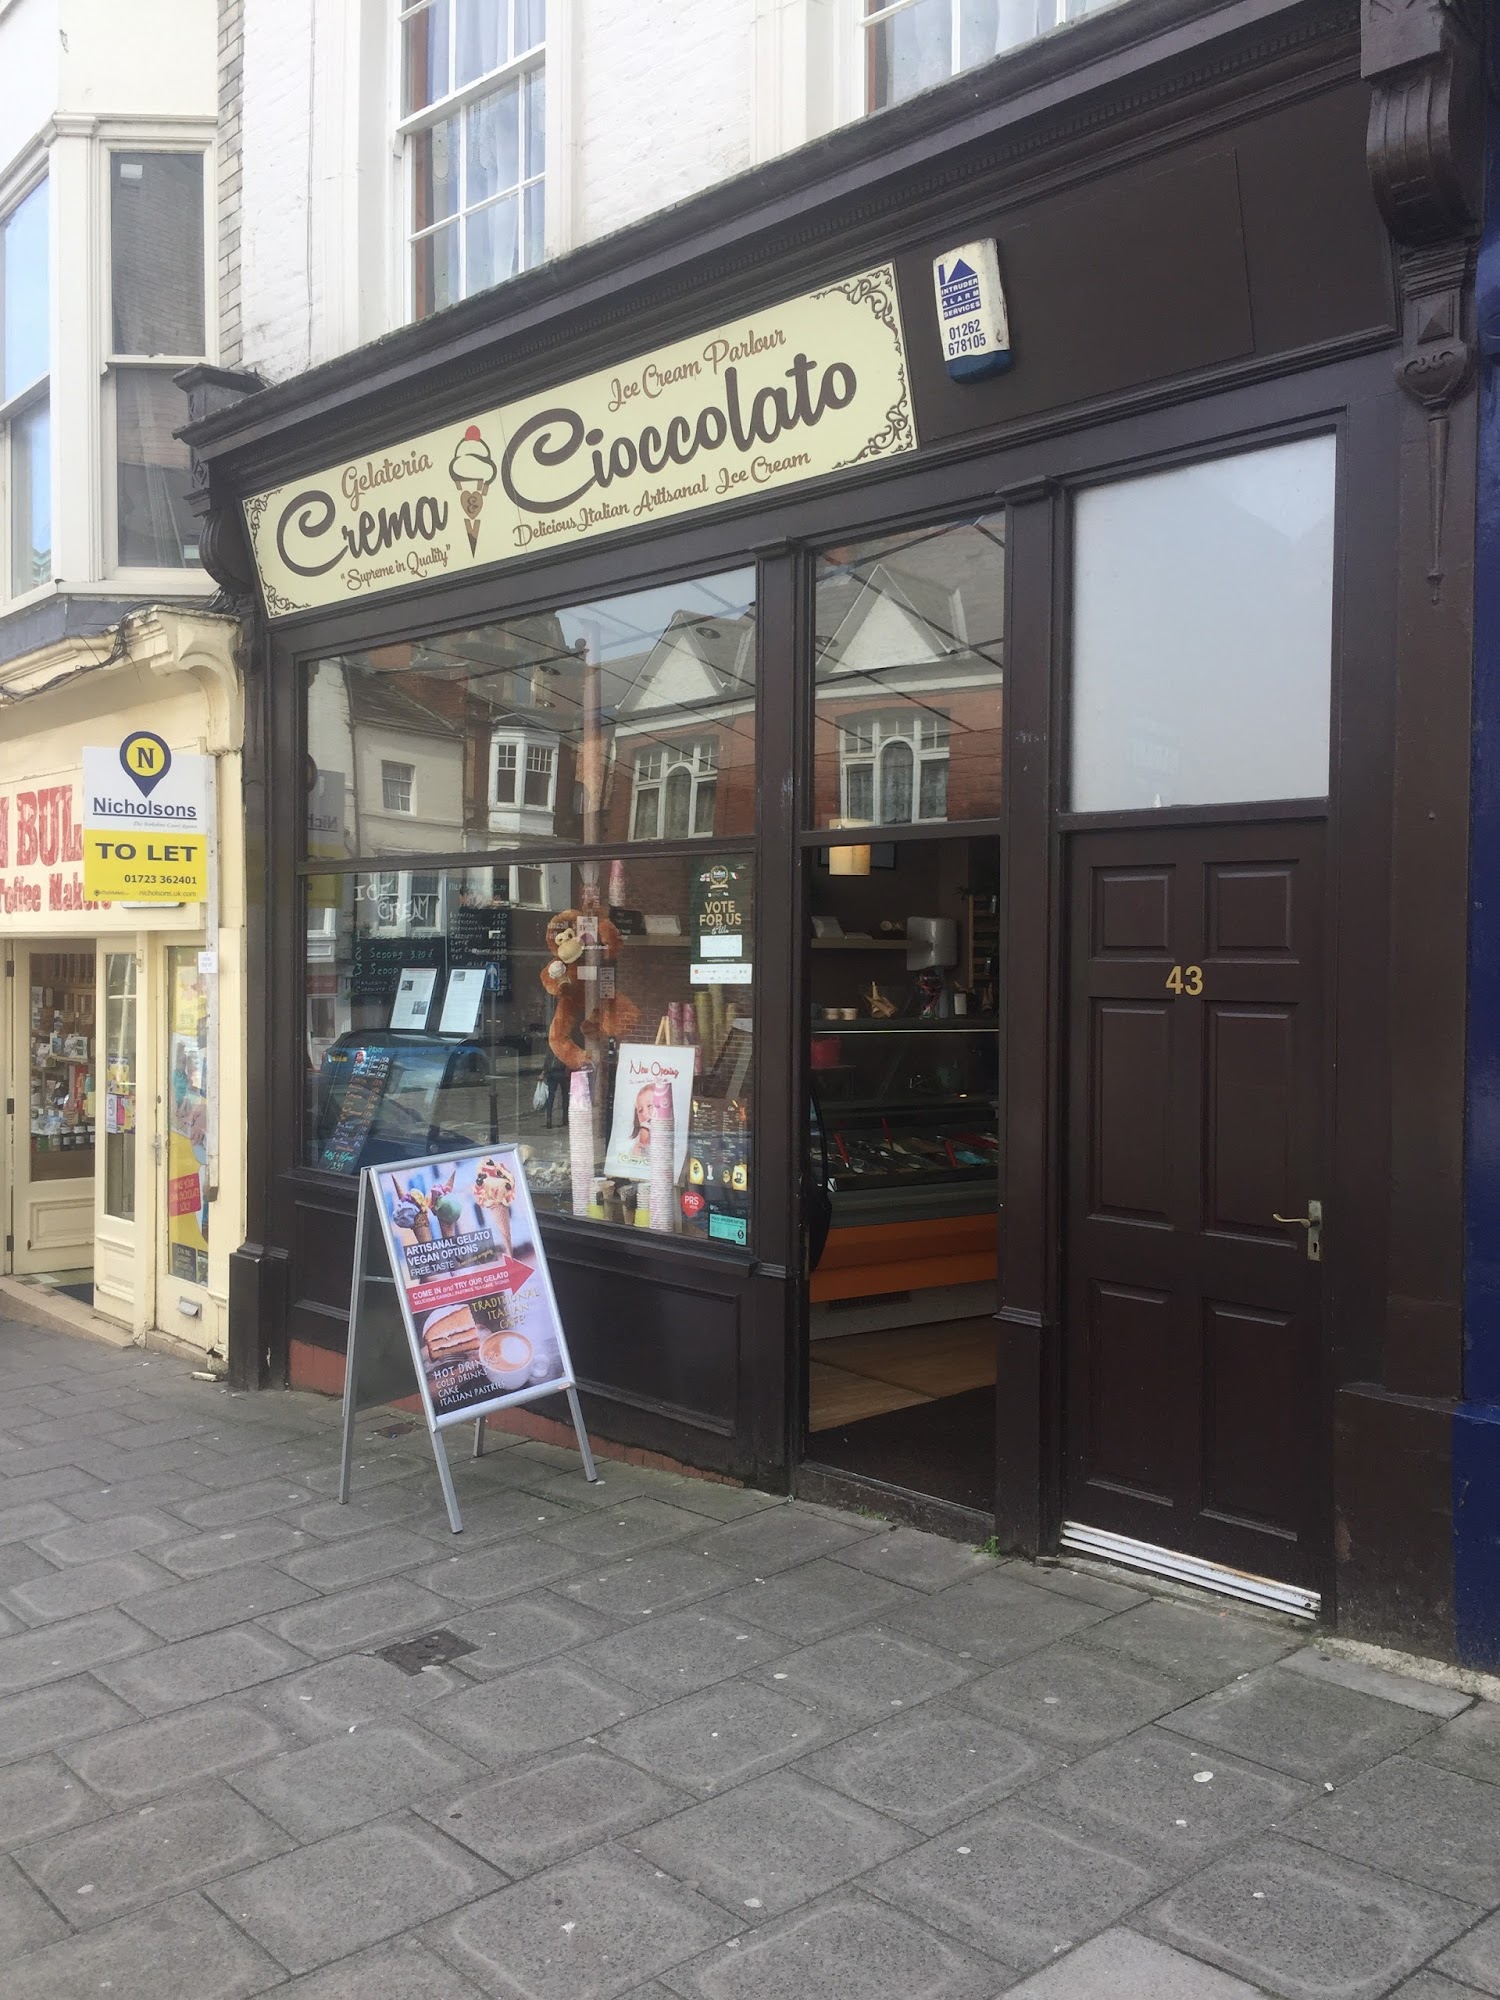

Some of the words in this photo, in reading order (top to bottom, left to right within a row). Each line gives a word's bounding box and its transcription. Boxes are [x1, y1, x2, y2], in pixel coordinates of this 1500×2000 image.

[940, 278, 978, 296] INTRUDER
[942, 289, 980, 307] ALARM
[943, 302, 981, 319] SERVICES
[949, 319, 981, 341] 01262
[948, 333, 986, 356] 678105
[608, 378, 641, 412] Ice
[642, 360, 702, 399] Cream
[702, 329, 786, 375] Parlour
[501, 353, 857, 514] Cioccolato
[341, 450, 433, 511] Gelateria
[512, 518, 577, 547] Delicious
[577, 501, 630, 532] Italian
[633, 474, 709, 516] Artisanal
[715, 468, 749, 494] Ice
[751, 453, 811, 483] Cream
[276, 490, 449, 577] Crema
[395, 560, 406, 573] in
[137, 746, 155, 769] N
[93, 797, 197, 818] Nicholsons
[95, 843, 137, 860] TO
[147, 845, 198, 862] LET
[124, 874, 157, 884] 01723
[160, 875, 197, 885] 362401
[354, 880, 395, 901] ICE
[377, 893, 430, 921] CREAM
[704, 900, 735, 914] VOTE
[699, 914, 723, 928] FOR
[726, 912, 742, 926] US
[1165, 965, 1204, 996] 43
[650, 1061, 680, 1079] Opening
[684, 1195, 699, 1206] PRS
[406, 1238, 456, 1257] ARTISANAL
[456, 1230, 491, 1246] GELATO
[407, 1252, 441, 1267] VEGAN
[441, 1243, 479, 1259] OPTIONS
[410, 1266, 431, 1278] FREE
[431, 1261, 455, 1273] TASTE
[412, 1288, 433, 1300] COME
[434, 1286, 442, 1295] IN
[454, 1281, 468, 1291] TRY
[468, 1277, 483, 1287] OUR
[483, 1270, 509, 1283] GELATO
[471, 1288, 540, 1312] TRADITIONAL
[487, 1302, 529, 1321] ITALIAN
[432, 1366, 455, 1380] HOT
[457, 1353, 499, 1371] DRINKS
[435, 1376, 457, 1390] COLD
[457, 1367, 489, 1383] DRINKS
[437, 1385, 459, 1398] CAKE
[439, 1390, 473, 1407] ITALIAN
